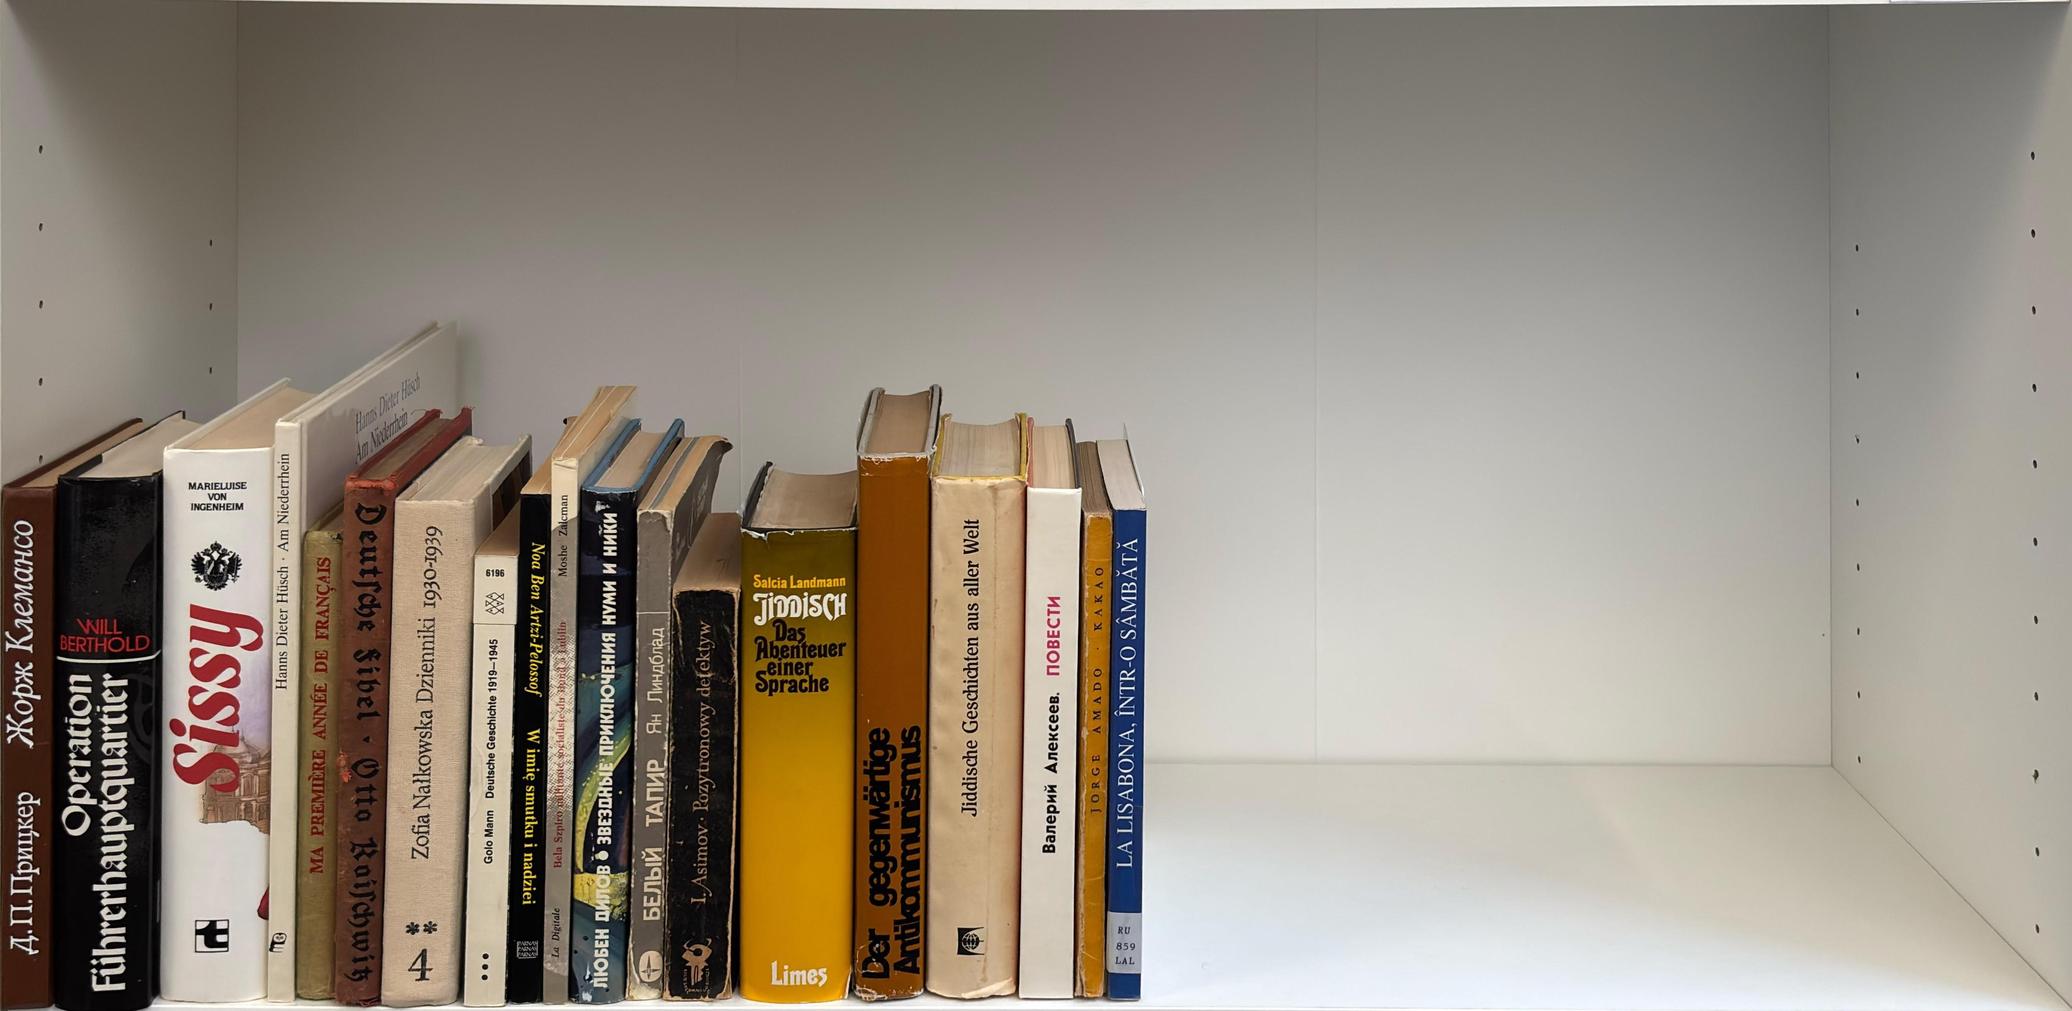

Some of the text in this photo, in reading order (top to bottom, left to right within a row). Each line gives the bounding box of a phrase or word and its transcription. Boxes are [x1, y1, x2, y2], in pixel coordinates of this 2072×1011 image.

[355, 406, 378, 434] Hanns
[379, 391, 400, 416] Dieter
[355, 440, 369, 464] Am
[188, 482, 247, 491] MARIELUISE
[190, 503, 244, 511] INGENHEIM
[207, 493, 227, 501] VON
[531, 542, 546, 570] Noa
[558, 495, 569, 577] Moshe Zalcman
[5, 520, 34, 653] Клемансо
[275, 453, 290, 690] Hanns Dieter Hüsch Am Niederrhein
[485, 568, 505, 577] 6196
[530, 575, 545, 601] Ben
[753, 574, 846, 588] Salcia Landmann
[60, 635, 150, 652] BERTHOLD
[76, 618, 122, 635] WILL
[754, 636, 847, 661] Abenteuer
[772, 619, 806, 642] Das
[524, 604, 545, 697] Artzi-Pelossof
[696, 621, 715, 697] defektyw
[767, 657, 814, 676] einer
[961, 519, 980, 817] Jiddische Geschichten aus aller Welt
[6, 661, 42, 749] Жорж
[169, 604, 264, 793] Sissy
[411, 526, 443, 860] Zofia Nałkowska Dzienniki 1930-1939
[556, 697, 567, 710] du
[755, 670, 829, 696] Sprache
[1091, 567, 1104, 814] JORGE AMADO KAKAO
[1114, 538, 1138, 868] LA LISABONA, ÎNTR-O SÂMBĂTĂ
[308, 557, 336, 874] MA PREMIÈRE ANNÉE DE FRANÇAIS
[486, 695, 498, 750] Geschichte
[526, 728, 541, 744] W
[555, 714, 567, 759] socialiste
[1042, 596, 1061, 854] Валерий Алексеев. ПОВЕСТИ
[61, 674, 98, 837] Operation
[522, 748, 541, 781] imię
[593, 512, 618, 988] ЛЮБЕН ДИЛОВ ЗВЕЗДНЫЕ ПРИКЛЮЧЕНИЯ НУМИ И НИКИ
[692, 702, 716, 812] Pozytronowy
[350, 758, 380, 822] Otto
[484, 753, 496, 799] Deutsche
[641, 627, 666, 920] БЕЛЫЙ ТАПИР Ян Линдблад
[90, 673, 135, 992] Führerhauptquartier
[484, 809, 495, 837] Mann
[524, 784, 540, 839] smutku
[484, 839, 493, 864] Golo
[553, 847, 564, 868] Bela
[861, 727, 897, 979] Der gegenwärtige
[893, 725, 921, 975] Antikommunismus
[522, 853, 538, 905] nadziei
[551, 907, 562, 958] La Digitale
[1116, 943, 1136, 951] 859
[1117, 926, 1131, 935] RU
[408, 948, 433, 982] 4
[771, 960, 828, 987] Limes
[1115, 957, 1135, 965] LAL
